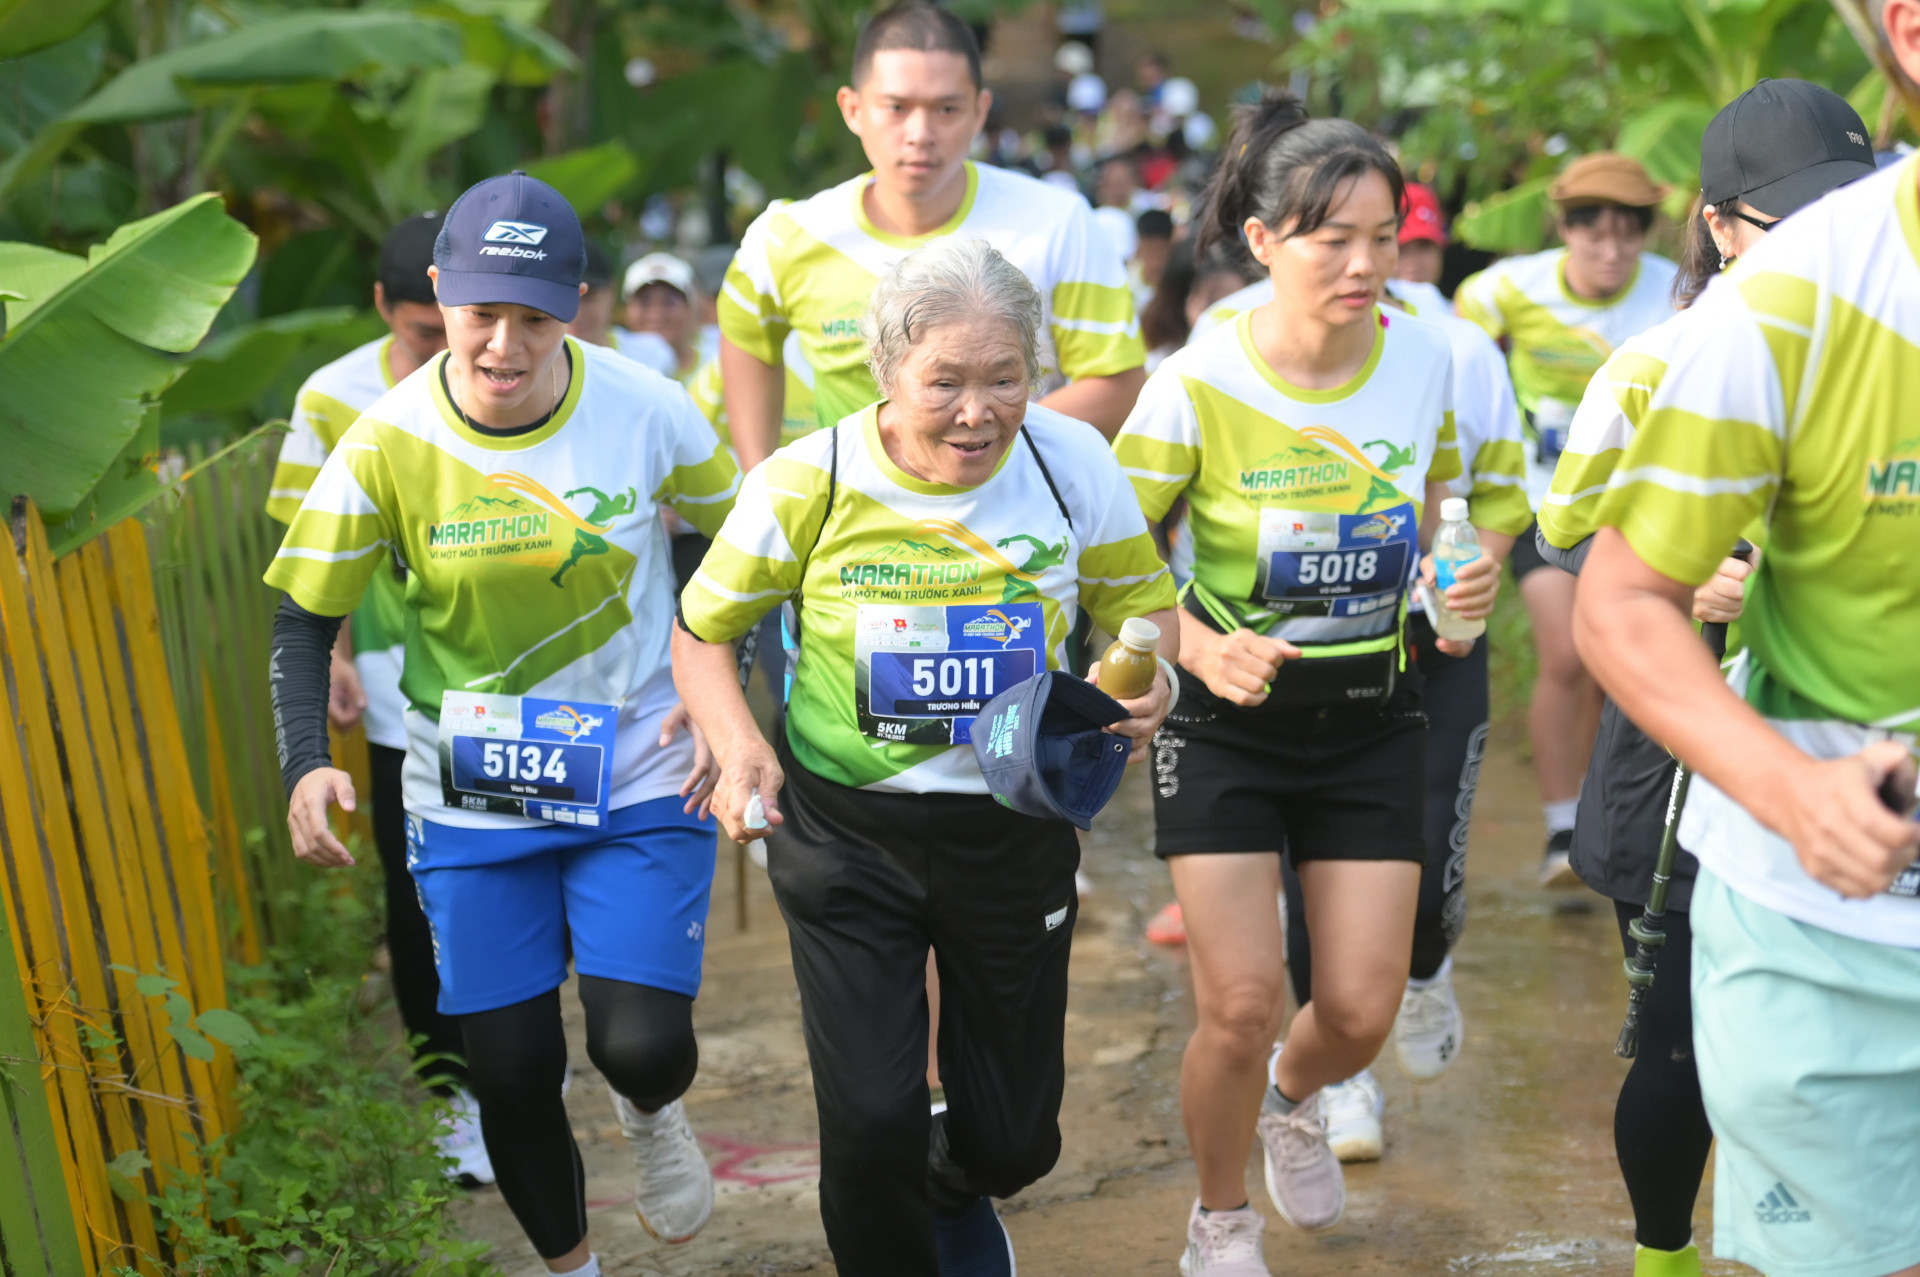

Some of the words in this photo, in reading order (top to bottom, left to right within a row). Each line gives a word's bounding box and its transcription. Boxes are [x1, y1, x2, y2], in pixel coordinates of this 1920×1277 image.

[479, 246, 547, 261] reebok
[1239, 461, 1349, 490] MARATHON
[429, 514, 548, 547] MARATHON
[460, 548, 478, 559] MÔI
[524, 540, 552, 551] XANH
[839, 561, 981, 588] MARATHON
[1298, 550, 1378, 585] 5018
[880, 588, 902, 600] MÔI
[952, 585, 982, 598] XANH
[912, 657, 994, 696] 5011
[877, 722, 907, 736] 5KM
[483, 742, 567, 784] 5134
[462, 795, 486, 806] 5KM
